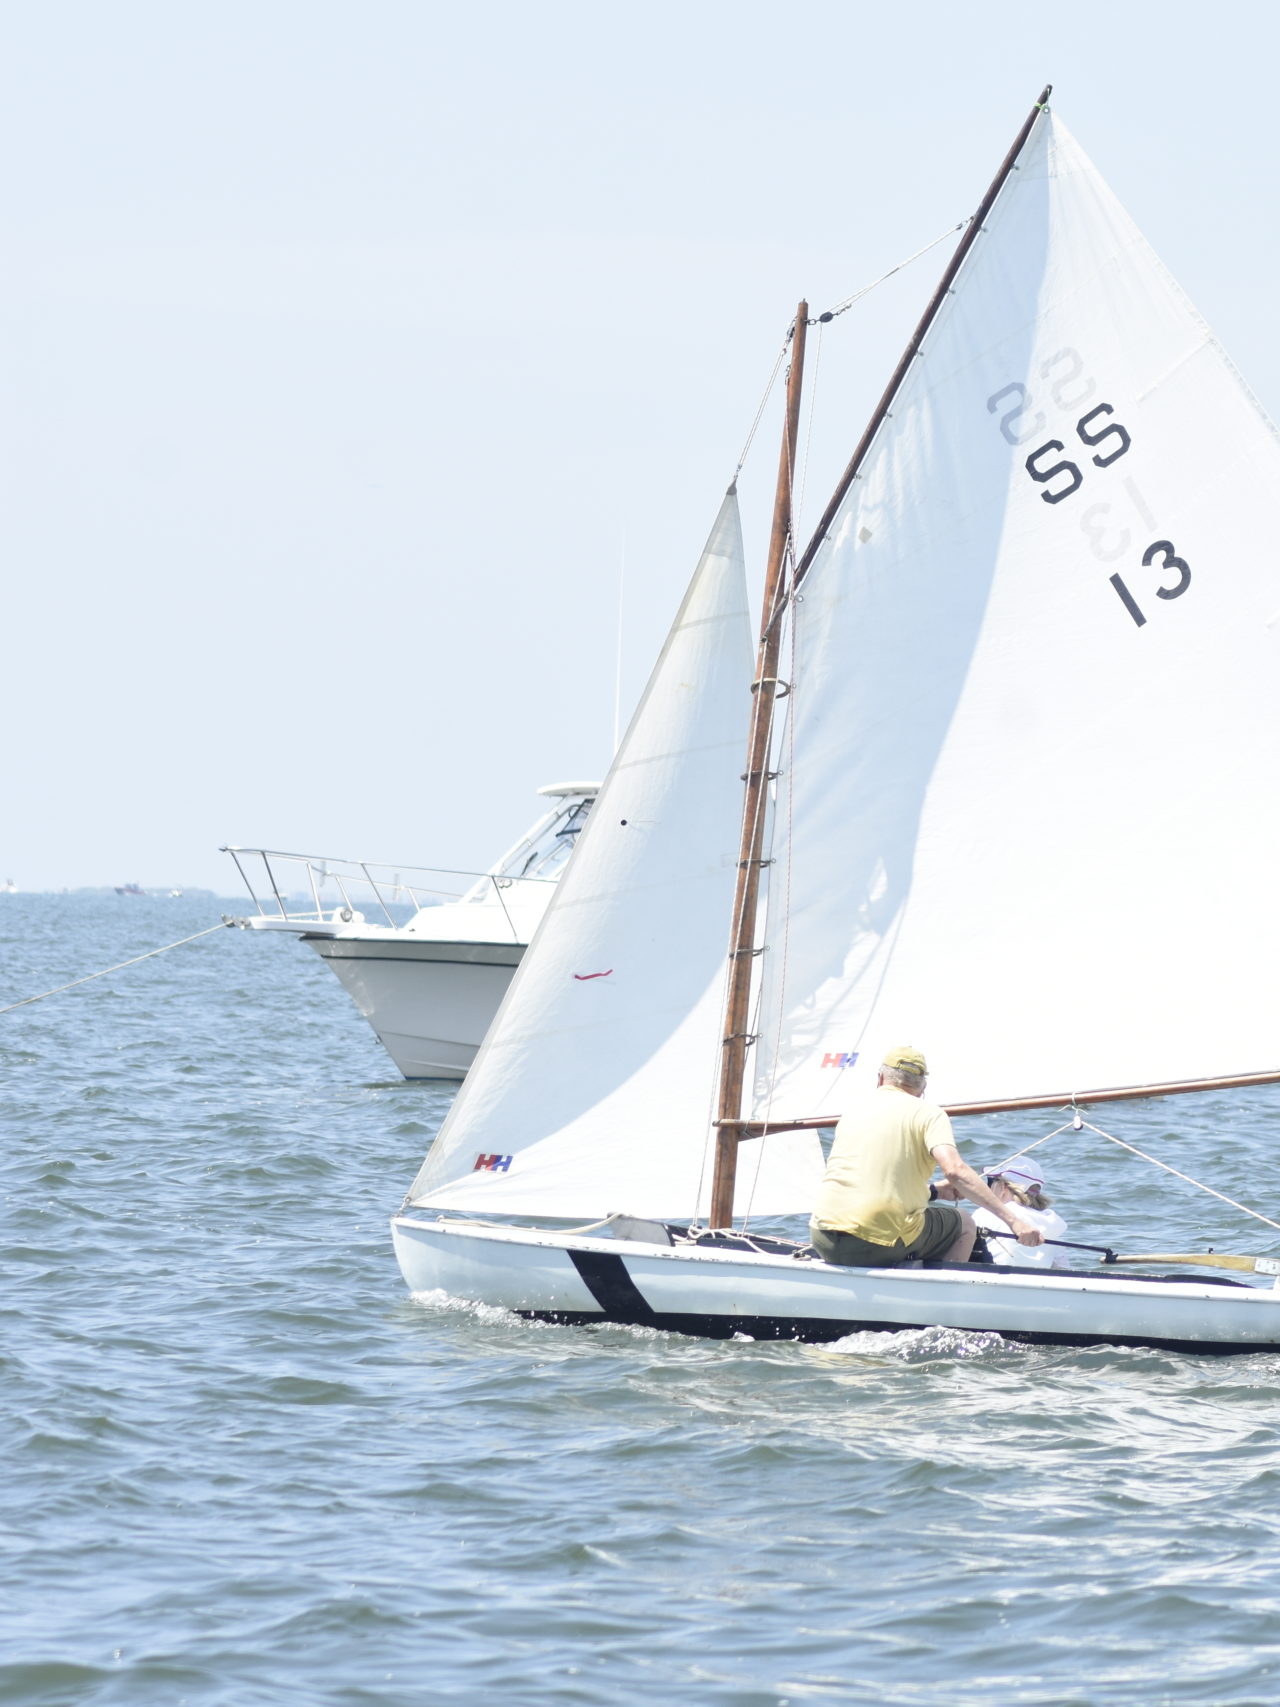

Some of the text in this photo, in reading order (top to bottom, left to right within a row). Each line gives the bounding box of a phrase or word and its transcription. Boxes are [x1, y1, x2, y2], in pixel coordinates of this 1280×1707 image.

[1025, 402, 1131, 505] SS
[1109, 539, 1192, 628] 13
[474, 1153, 514, 1173] HH
